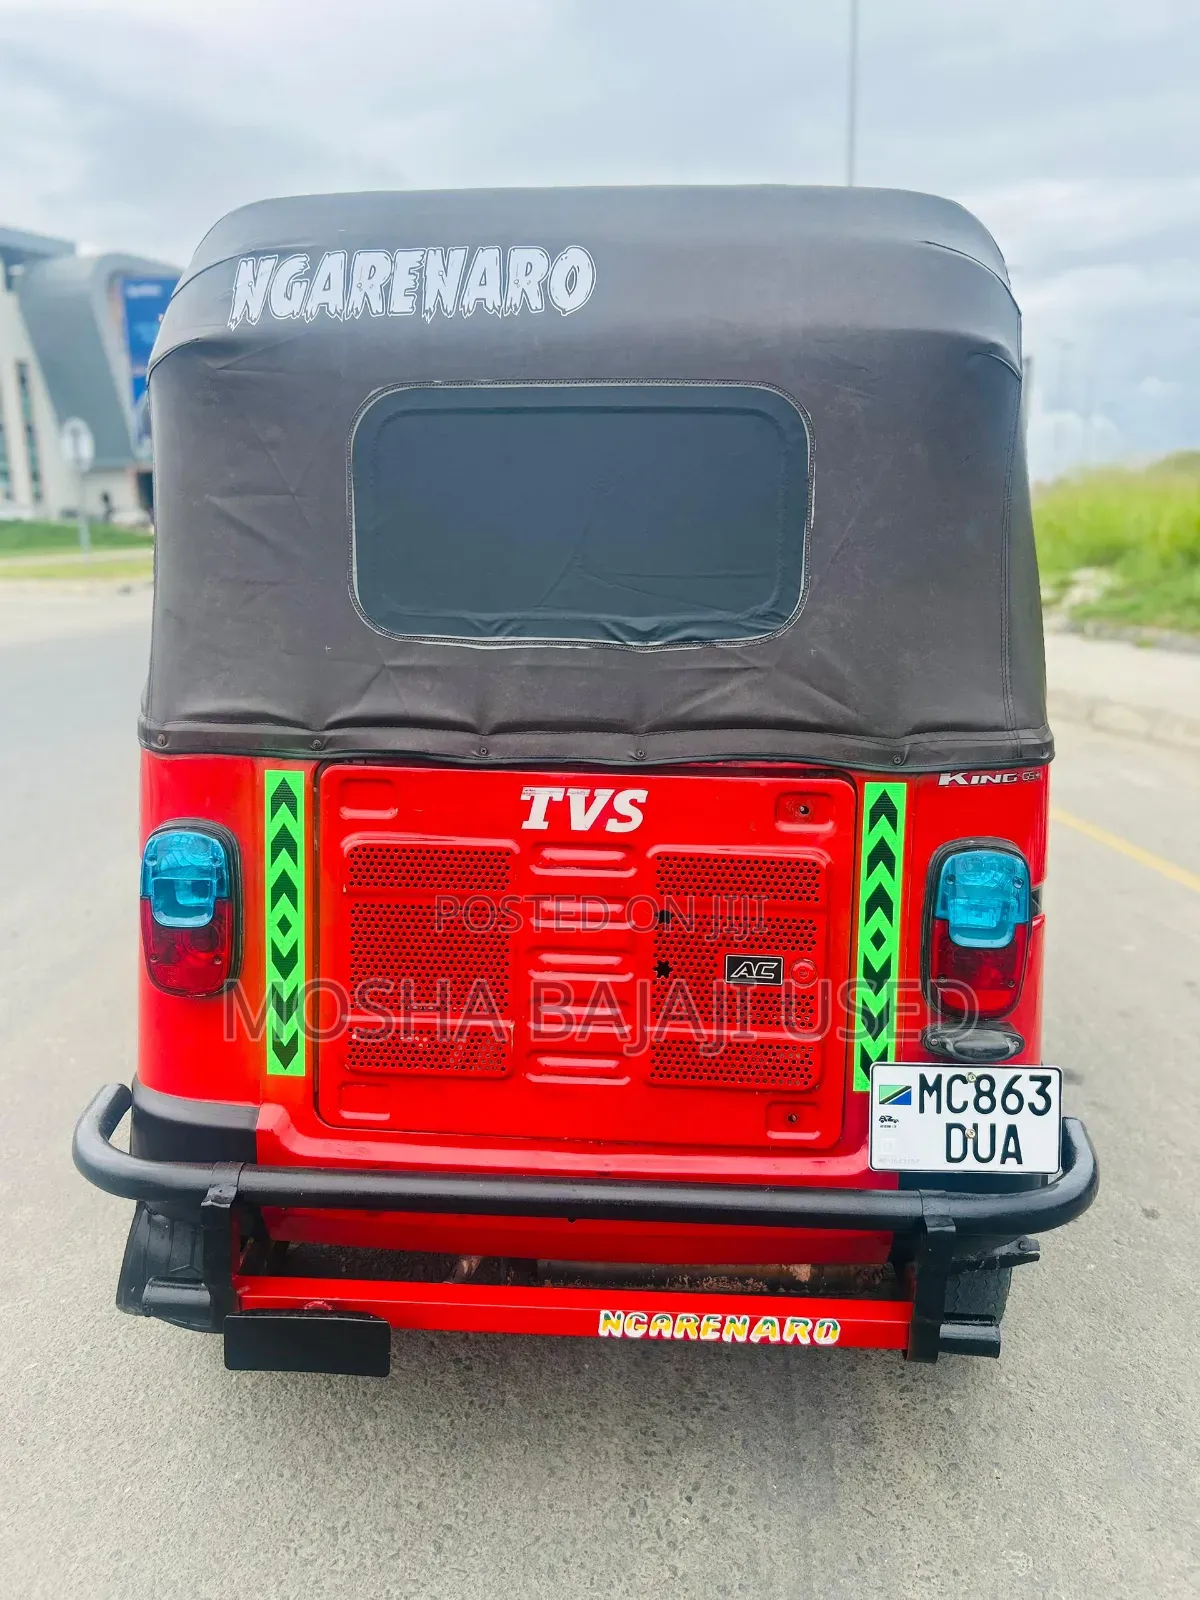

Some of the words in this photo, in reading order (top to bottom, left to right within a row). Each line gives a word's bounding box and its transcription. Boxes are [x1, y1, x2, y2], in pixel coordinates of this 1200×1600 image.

[227, 246, 597, 331] NGARENARO
[520, 787, 648, 833] TVS
[731, 961, 778, 979] AC
[918, 1073, 1052, 1116] MC863
[945, 1122, 1023, 1165] DUA
[597, 1310, 841, 1345] NGARENARO
